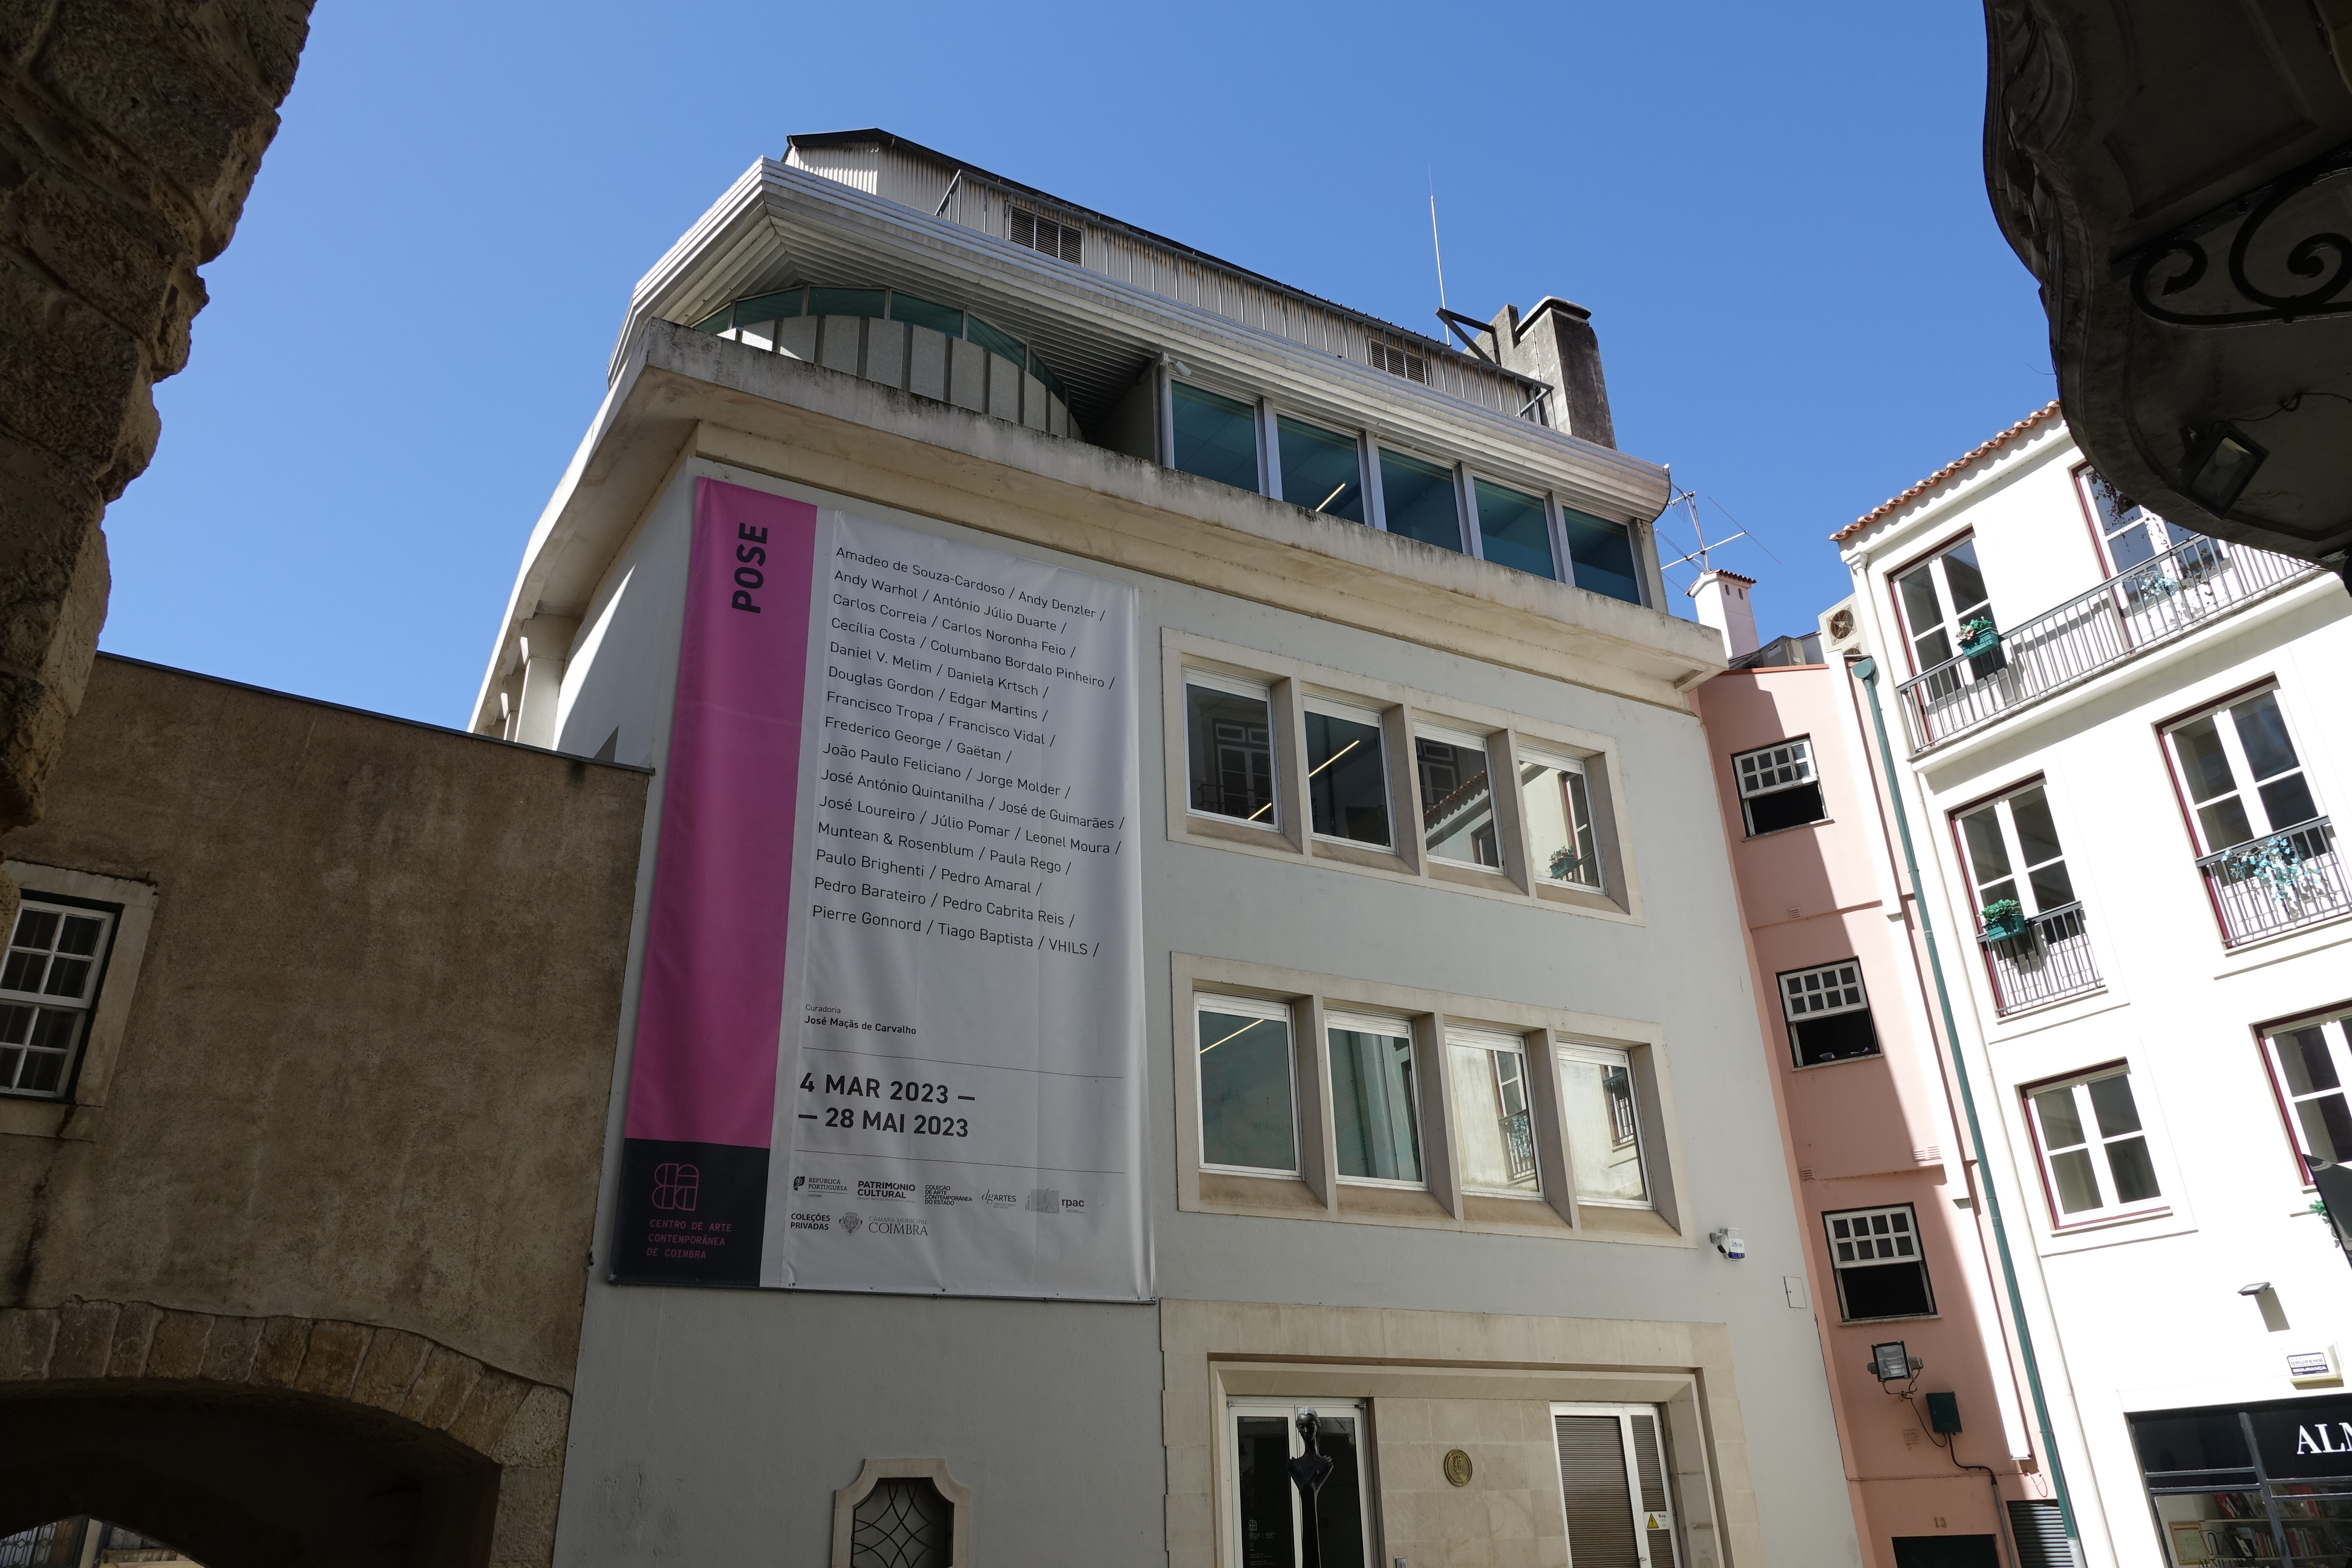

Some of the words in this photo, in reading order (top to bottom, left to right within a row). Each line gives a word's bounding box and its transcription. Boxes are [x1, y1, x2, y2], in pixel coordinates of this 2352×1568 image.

[732, 522, 768, 613] POSE
[836, 547, 888, 567] Amadeo
[893, 561, 907, 572] de
[913, 565, 1004, 595] Souza-Cardoso
[1009, 587, 1015, 599] /
[1019, 591, 1048, 609] Andy
[1053, 599, 1096, 618] Denzler
[1100, 610, 1105, 621] /
[834, 570, 867, 588] Andy
[872, 578, 917, 598] Warhol
[922, 589, 929, 601] /
[933, 593, 979, 612] António
[984, 606, 1012, 621] Júlio
[1018, 613, 1056, 630] Duarte
[1061, 622, 1067, 634] /
[834, 594, 875, 612] Carlos
[880, 604, 926, 624] Correia
[932, 615, 938, 627] /
[942, 619, 981, 636] Carlos
[987, 629, 1037, 649] Noronha
[1042, 641, 1065, 655] Feio
[1070, 646, 1076, 658] /
[831, 641, 872, 659] Daniel
[877, 651, 887, 664] V.
[893, 655, 931, 673] Melim
[936, 664, 943, 676] /
[948, 667, 993, 686] Daniela
[999, 678, 1037, 696] Krtsch
[1043, 687, 1049, 699] /
[832, 618, 874, 636] Cecília
[880, 629, 915, 645] Costa
[920, 636, 927, 648] /
[931, 640, 1001, 664] Columbano
[1006, 656, 1052, 675] Bordalo
[1057, 667, 1104, 687] Pinheiro
[1109, 677, 1115, 690] /
[829, 666, 882, 687] Douglas
[887, 679, 933, 698] Gordon
[938, 688, 946, 701] /
[950, 691, 987, 708] Edgar
[991, 700, 1037, 719] Martins
[1042, 710, 1048, 722] /
[826, 716, 890, 738] Frederico
[895, 730, 941, 750] George
[946, 739, 953, 752] /
[957, 742, 1001, 760] Gaëtan
[1005, 751, 1012, 763] /
[828, 691, 892, 713] Francisco
[896, 704, 932, 722] Tropa
[938, 713, 944, 725] /
[949, 716, 1009, 737] Francisco
[1014, 728, 1045, 744] Vidal
[1050, 734, 1056, 747] /
[823, 743, 855, 757] João
[861, 749, 898, 766] Paulo
[904, 757, 961, 777] Feliciano
[965, 768, 972, 781] /
[976, 771, 1013, 788] Jorge
[1018, 778, 1060, 795] Molder
[1065, 786, 1071, 799] /
[821, 769, 853, 783] José
[857, 775, 907, 793] António
[912, 785, 983, 808] Quintanilha
[988, 797, 995, 810] /
[999, 801, 1027, 815] José
[1031, 806, 1045, 818] de
[1050, 809, 1114, 828] Guimarães
[1119, 817, 1125, 830] /
[818, 822, 878, 842] Muntean
[883, 833, 893, 845] &
[899, 835, 973, 857] Rosenblum
[978, 847, 985, 860] /
[990, 850, 1025, 866] Paula
[1031, 857, 1060, 873] Rego
[1065, 862, 1071, 875] /
[819, 795, 852, 810] José
[858, 801, 915, 821] Loureiro
[920, 811, 927, 824] /
[931, 814, 963, 829] Júlio
[969, 820, 1010, 837] Pomar
[1014, 827, 1021, 840] /
[1027, 830, 1066, 848] Leonel
[1071, 838, 1109, 853] Moura
[1115, 841, 1122, 854] /
[817, 849, 856, 866] Paulo
[861, 855, 924, 877] Brighenti
[929, 865, 936, 880] /
[942, 868, 980, 885] Pedro
[984, 875, 1031, 893] Amaral
[1036, 882, 1042, 896] /
[815, 877, 856, 894] Pedro
[862, 884, 926, 904] Barateiro
[930, 893, 938, 907] /
[943, 896, 982, 912] Pedro
[987, 903, 1033, 920] Cabrita
[1039, 910, 1064, 925] Reis
[1069, 914, 1075, 928] /
[813, 905, 856, 923] Pierre
[862, 912, 921, 932] Gonnord
[926, 920, 934, 935] /
[938, 923, 975, 940] Tiago
[980, 929, 1033, 947] Baptista
[1038, 935, 1044, 950] /
[1049, 938, 1087, 955] VHILS
[1093, 942, 1099, 957] /
[805, 1016, 826, 1025] José
[830, 1018, 858, 1029] Maçãs
[875, 1024, 916, 1034] Carvalho
[806, 1004, 840, 1013] Curadoria
[800, 1073, 815, 1092] 4
[826, 1074, 880, 1098] MAR
[890, 1081, 948, 1103] 2023
[825, 1107, 854, 1128] 28
[863, 1110, 904, 1133] MAI
[913, 1115, 968, 1137] 2023
[791, 1213, 830, 1223] COLEÇÕES
[857, 1189, 906, 1198] CULTURAL
[1062, 1199, 1085, 1208] rpac
[648, 1233, 725, 1246] CONTEMPORÂNEA
[650, 1220, 686, 1229] CENTRO
[691, 1221, 703, 1230] DE
[708, 1223, 732, 1232] ARTE
[790, 1222, 829, 1230] PRIVADAS
[869, 1222, 929, 1235] COIMBRA
[646, 1247, 659, 1256] DE
[664, 1249, 707, 1259] COIMBRA
